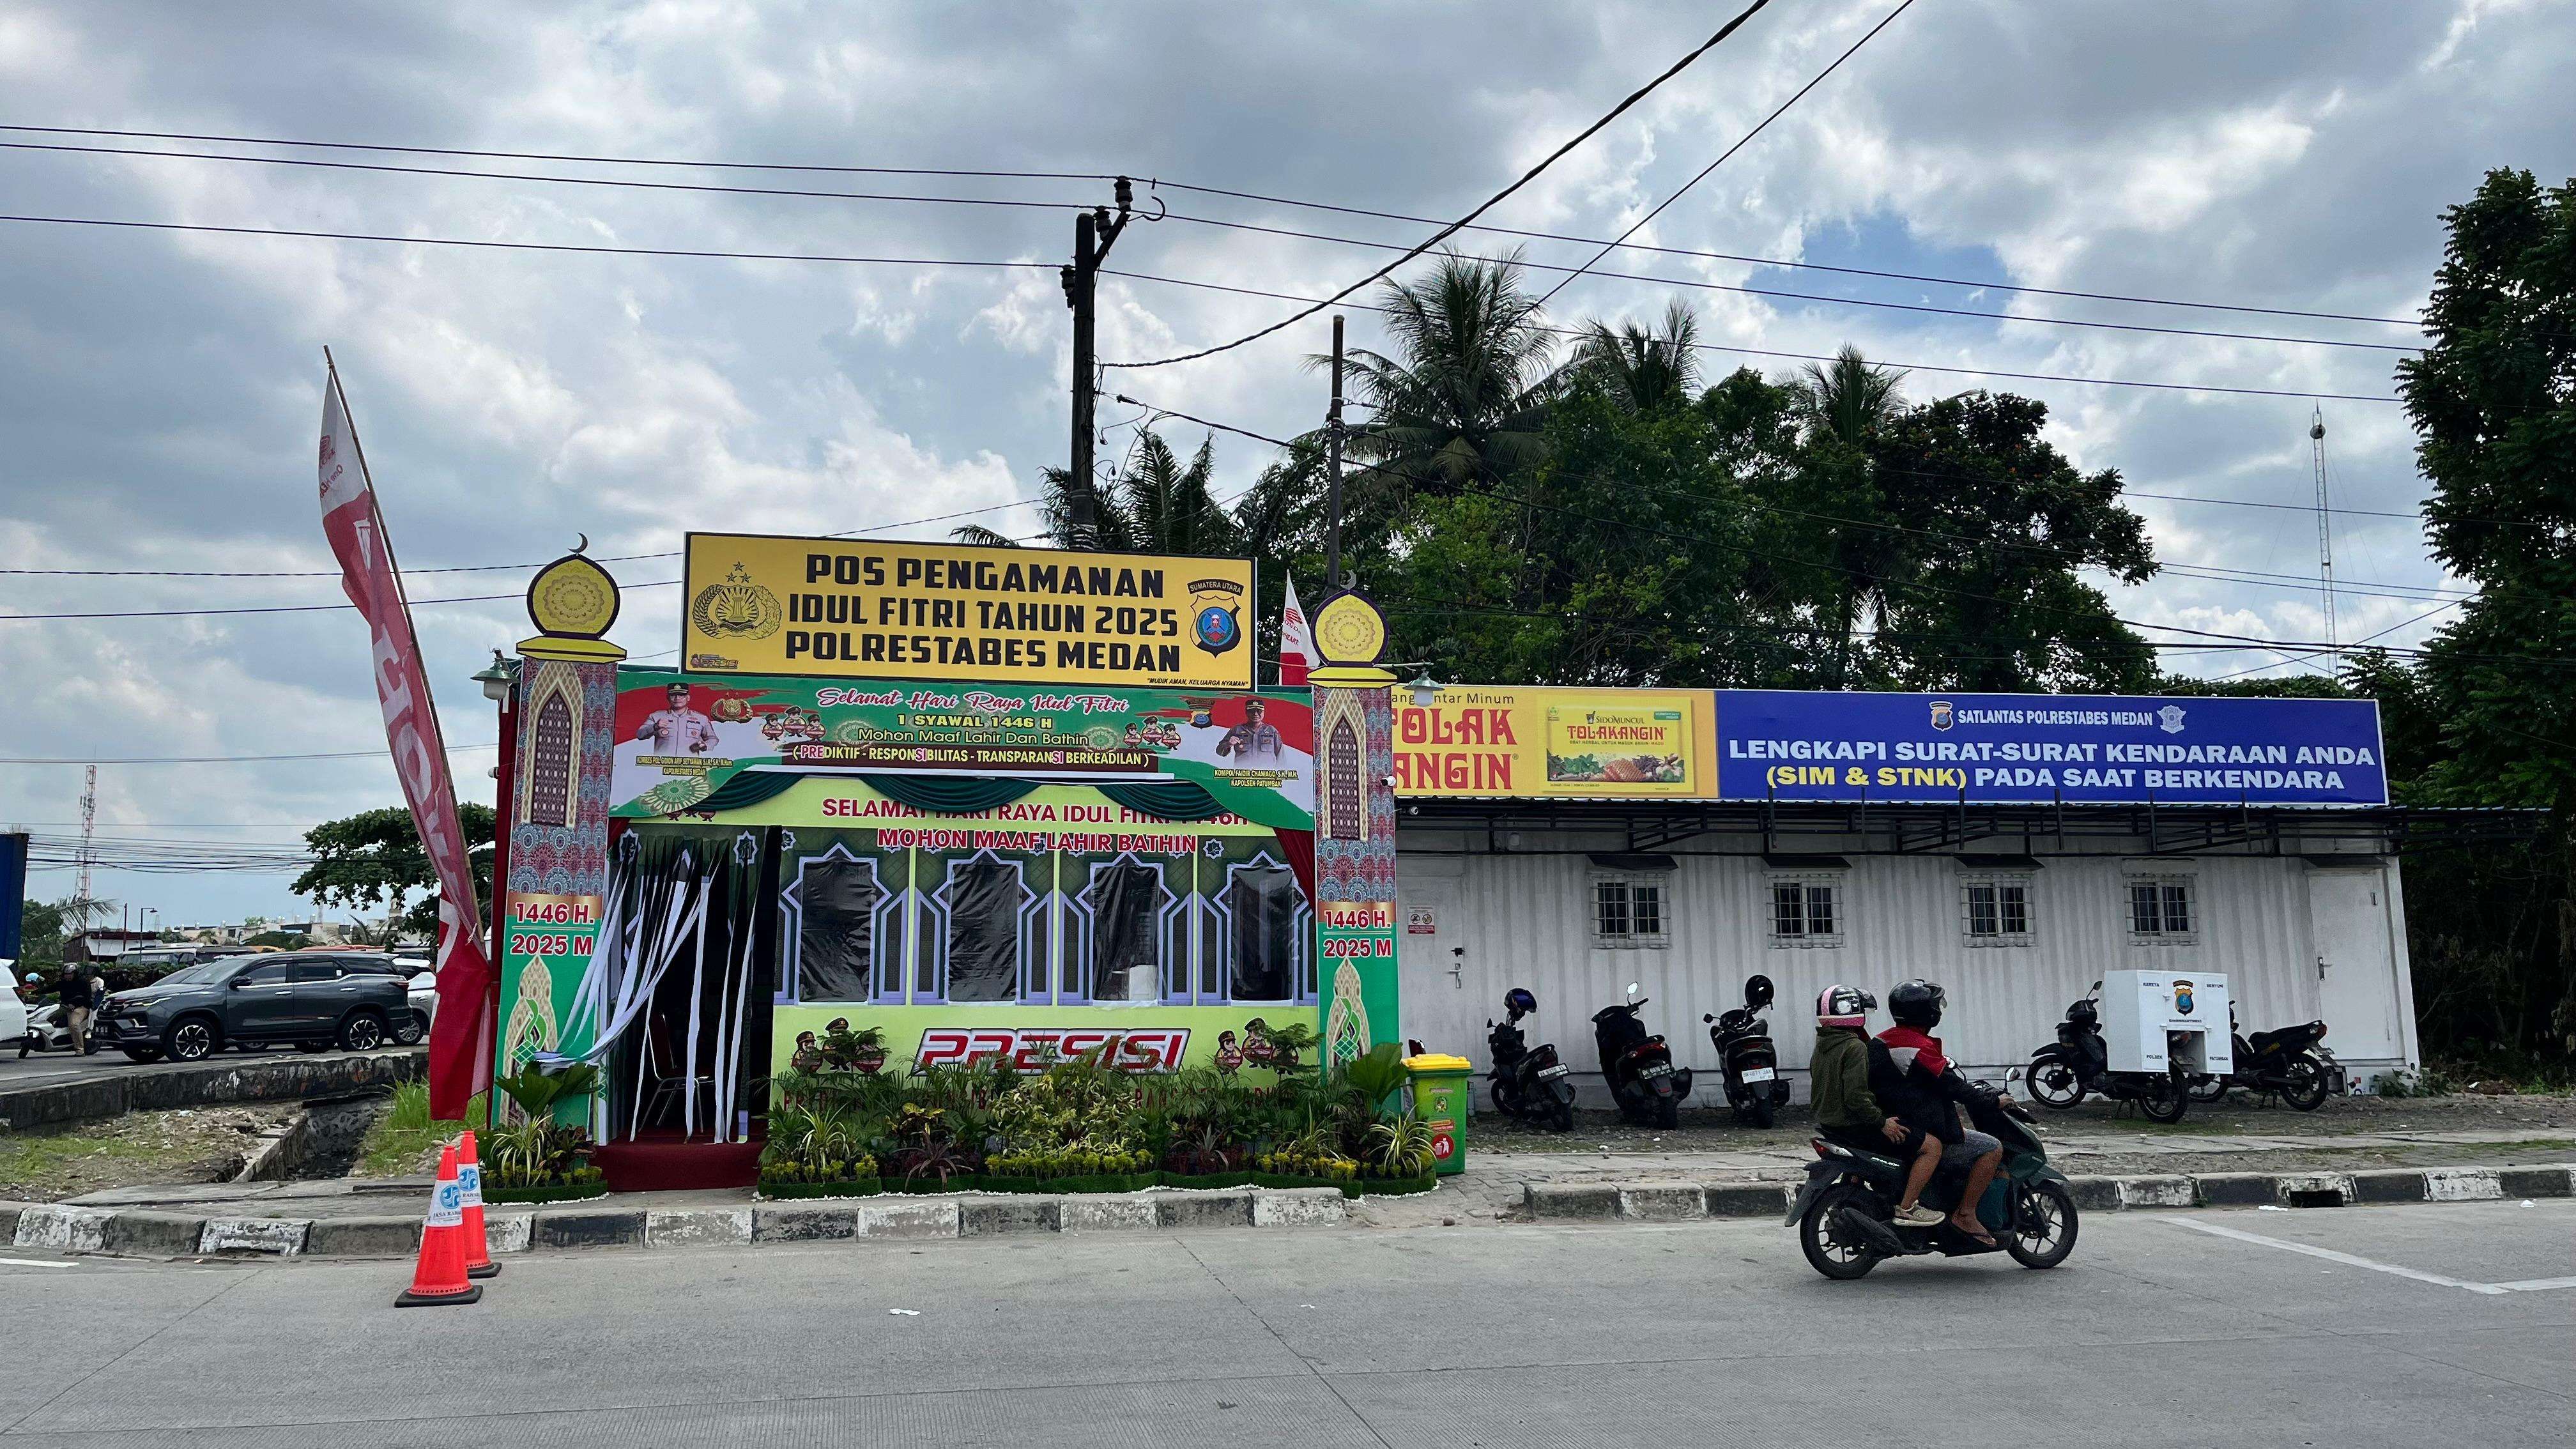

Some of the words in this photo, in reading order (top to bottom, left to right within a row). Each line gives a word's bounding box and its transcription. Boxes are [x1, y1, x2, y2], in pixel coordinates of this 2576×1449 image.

[807, 554, 884, 586] POS
[897, 558, 1163, 598] PENGAMANAN
[1190, 581, 1221, 592] SUMATERA
[1222, 583, 1241, 593] UTARA
[790, 594, 868, 624] IDUL
[880, 597, 965, 629] FITRI
[977, 601, 1084, 632] TAHUN
[1095, 606, 1177, 636] 2025
[786, 631, 1046, 667] POLRESTABES
[1057, 641, 1180, 672] MEDAN
[816, 687, 903, 707] Selamat
[907, 691, 958, 710] Hari
[964, 692, 1024, 712] Raya
[1029, 694, 1075, 712] Idul
[1075, 694, 1129, 714] Fitri
[1467, 693, 1514, 703] Minum
[898, 714, 906, 725] 1
[914, 715, 983, 728] SYAWAL
[992, 717, 1034, 728] 1446
[1041, 718, 1052, 728] H
[1958, 710, 2023, 724] SATLANTAS
[2027, 710, 2108, 726] POLRESTABES
[2112, 711, 2153, 726] MEDAN
[859, 729, 914, 742] Mohon
[919, 730, 960, 742] Maaf
[965, 732, 1001, 744] Lahir
[1006, 733, 1037, 744] Dan
[1043, 733, 1089, 745] Bathin
[869, 747, 968, 762] RESPONSIBILITAS
[976, 750, 1064, 765] TRANSPARANSI
[1729, 739, 1887, 761] LENGKAPI
[1895, 742, 2098, 763] SURAT-SURAT
[2106, 743, 2287, 765] KENDARAAN
[2296, 746, 2375, 766] ANDA
[1766, 766, 1835, 790] (SIM
[1845, 767, 1869, 786] &
[1877, 767, 1966, 790] STNK)
[1975, 768, 2056, 787] PADA
[2063, 769, 2136, 787] SAAT
[2145, 769, 2345, 790] BERKENDARA
[997, 803, 1057, 822] RAYA
[1062, 805, 1114, 824] IDUL
[878, 829, 967, 848] MOHON
[974, 831, 1040, 850] MAAF
[1046, 832, 1112, 852] LAHIR
[1118, 834, 1196, 853] BATHIN
[516, 903, 568, 924] 1446
[574, 905, 594, 924] H.
[1324, 910, 1368, 928] 1446
[1374, 910, 1391, 928] H.
[510, 935, 567, 955] 2025
[572, 936, 594, 956] M
[1324, 939, 1370, 957] 2025
[1376, 939, 1392, 957] M
[921, 1034, 1183, 1070] PRESISI
